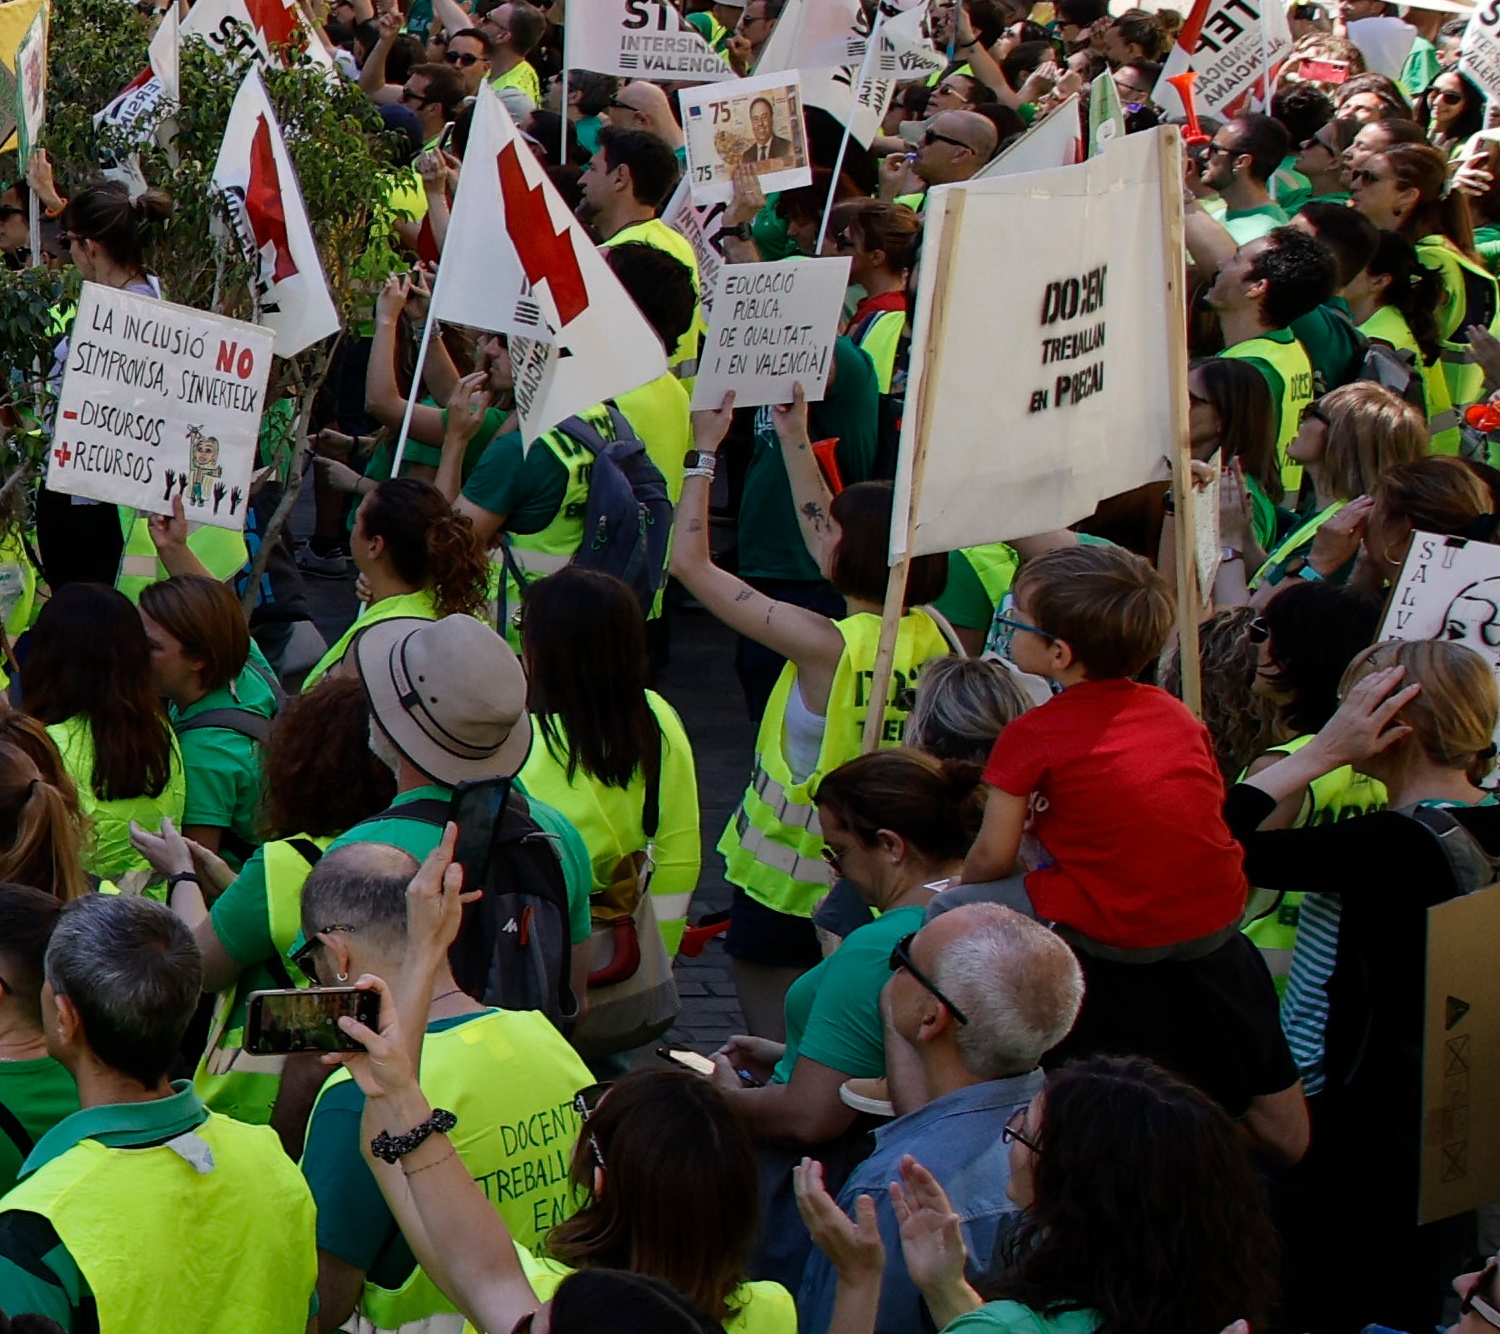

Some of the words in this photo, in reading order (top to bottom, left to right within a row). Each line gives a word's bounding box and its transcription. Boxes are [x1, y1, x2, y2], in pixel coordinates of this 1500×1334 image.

[709, 100, 731, 124] 75
[696, 165, 712, 182] 75
[725, 268, 797, 295] EDUCACIÓ
[92, 303, 113, 335] LA
[123, 315, 209, 359] INCLUSIÓ
[215, 340, 254, 380] NO
[719, 327, 737, 347] DE
[715, 357, 720, 373] I
[728, 355, 747, 374] EN
[1029, 389, 1048, 413] EN
[80, 399, 165, 447] DISCURSOS
[73, 441, 154, 484] RECURSOS
[500, 1101, 576, 1157] DOCENT
[534, 1194, 566, 1233] EN
